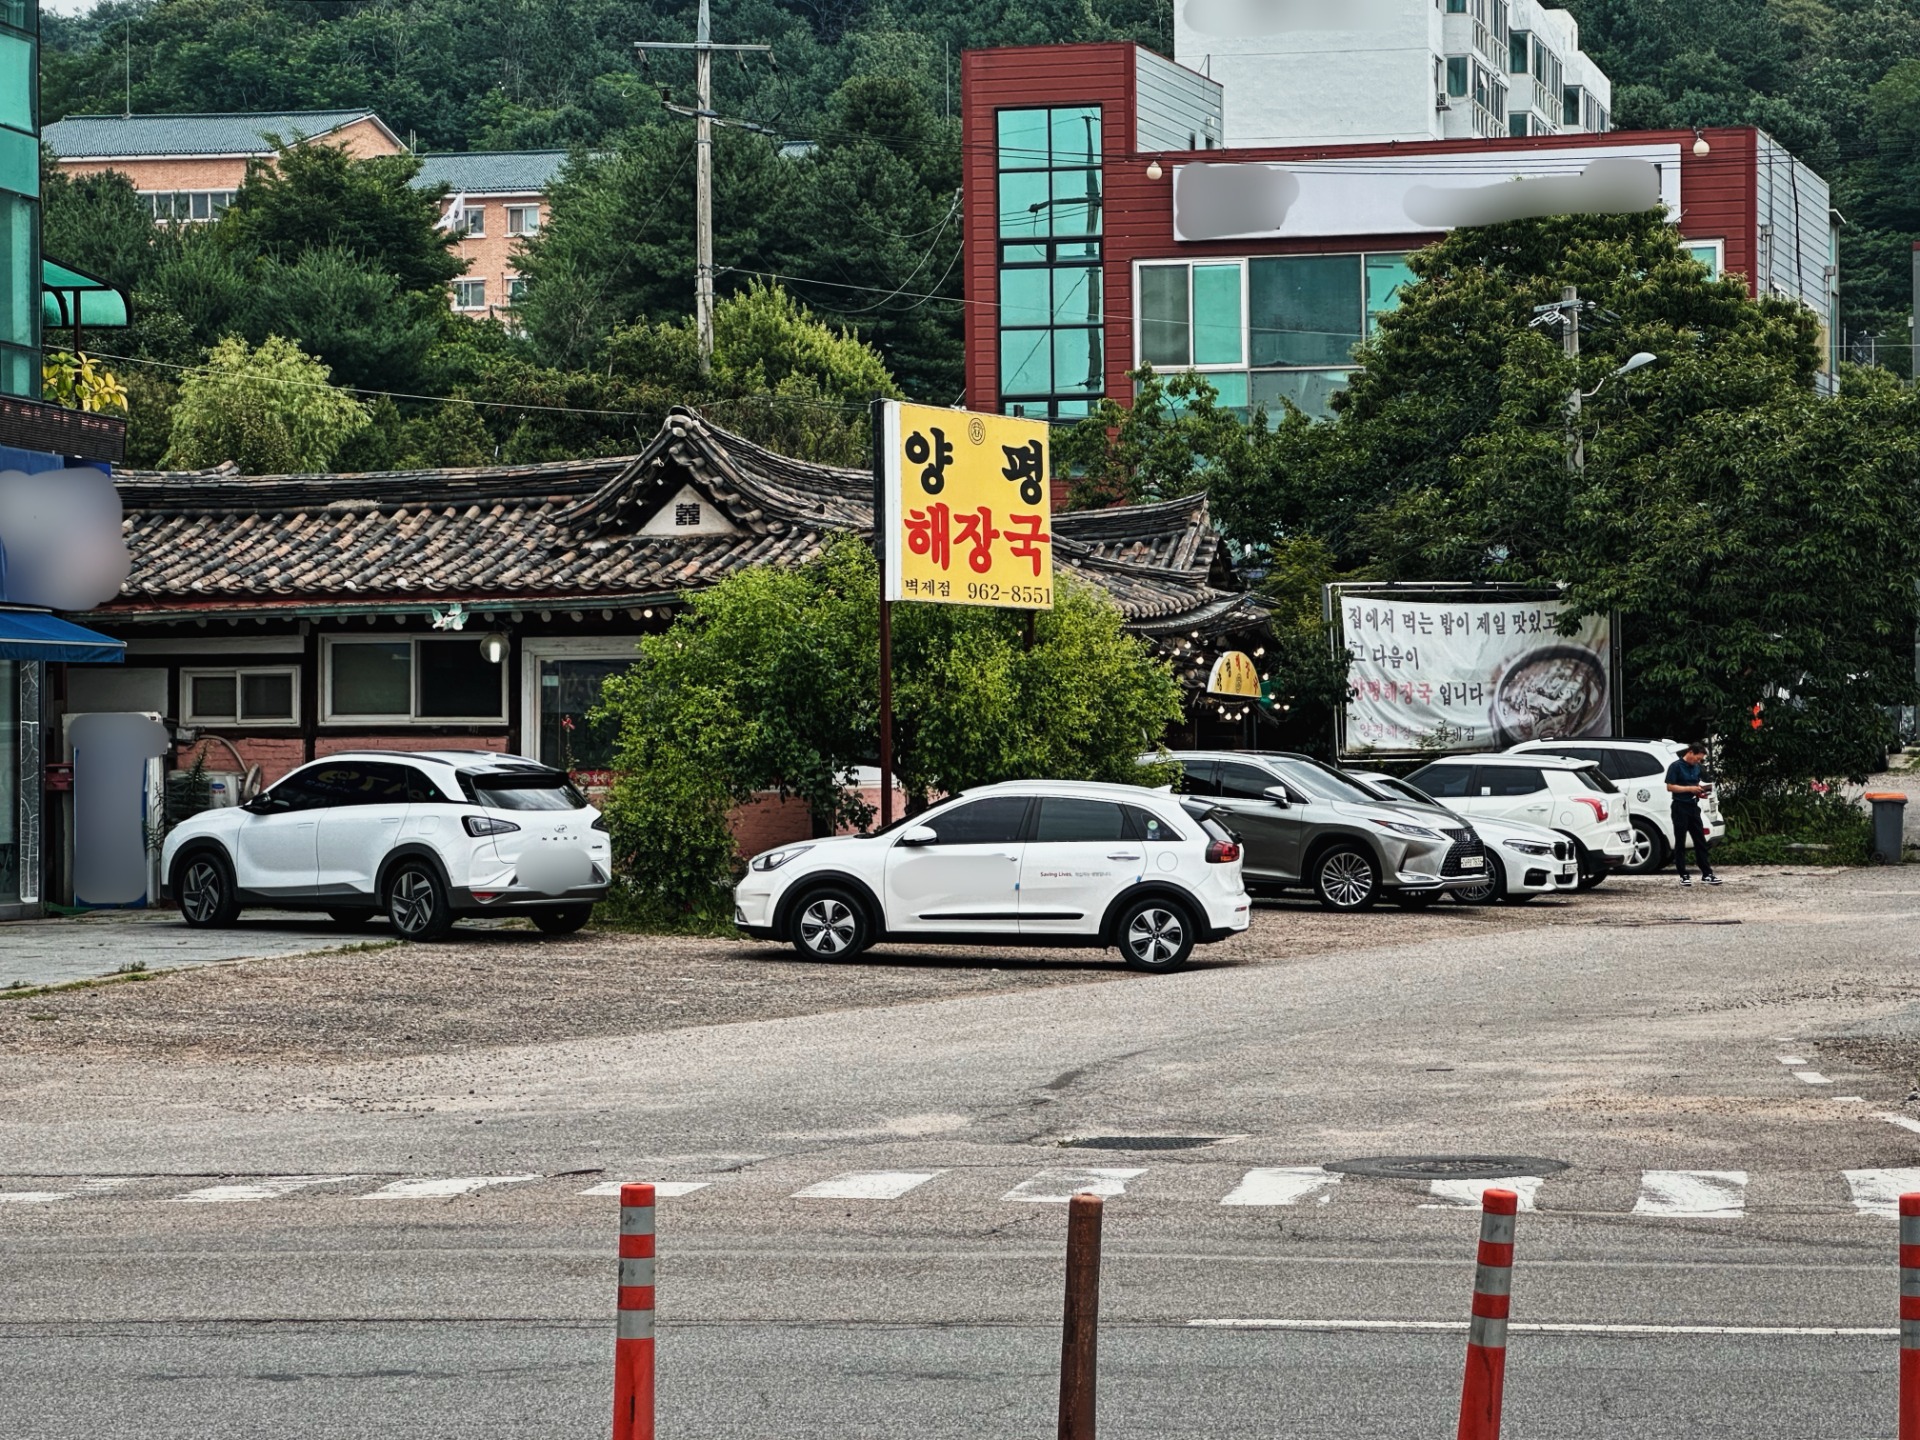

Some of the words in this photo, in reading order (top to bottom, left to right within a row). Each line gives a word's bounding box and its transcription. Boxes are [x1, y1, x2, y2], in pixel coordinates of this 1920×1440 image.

[904, 502, 1050, 577] 해장국
[905, 578, 951, 597] 벽제점
[967, 582, 1051, 604] 962-8551
[1348, 606, 1394, 634] 집에서
[1402, 611, 1434, 634] 먹는
[1440, 611, 1469, 635] 밥이
[1476, 611, 1506, 635] 제일
[1372, 644, 1419, 670] 다음이
[1352, 677, 1433, 705] 양평해장국
[1440, 682, 1484, 705] 입니다
